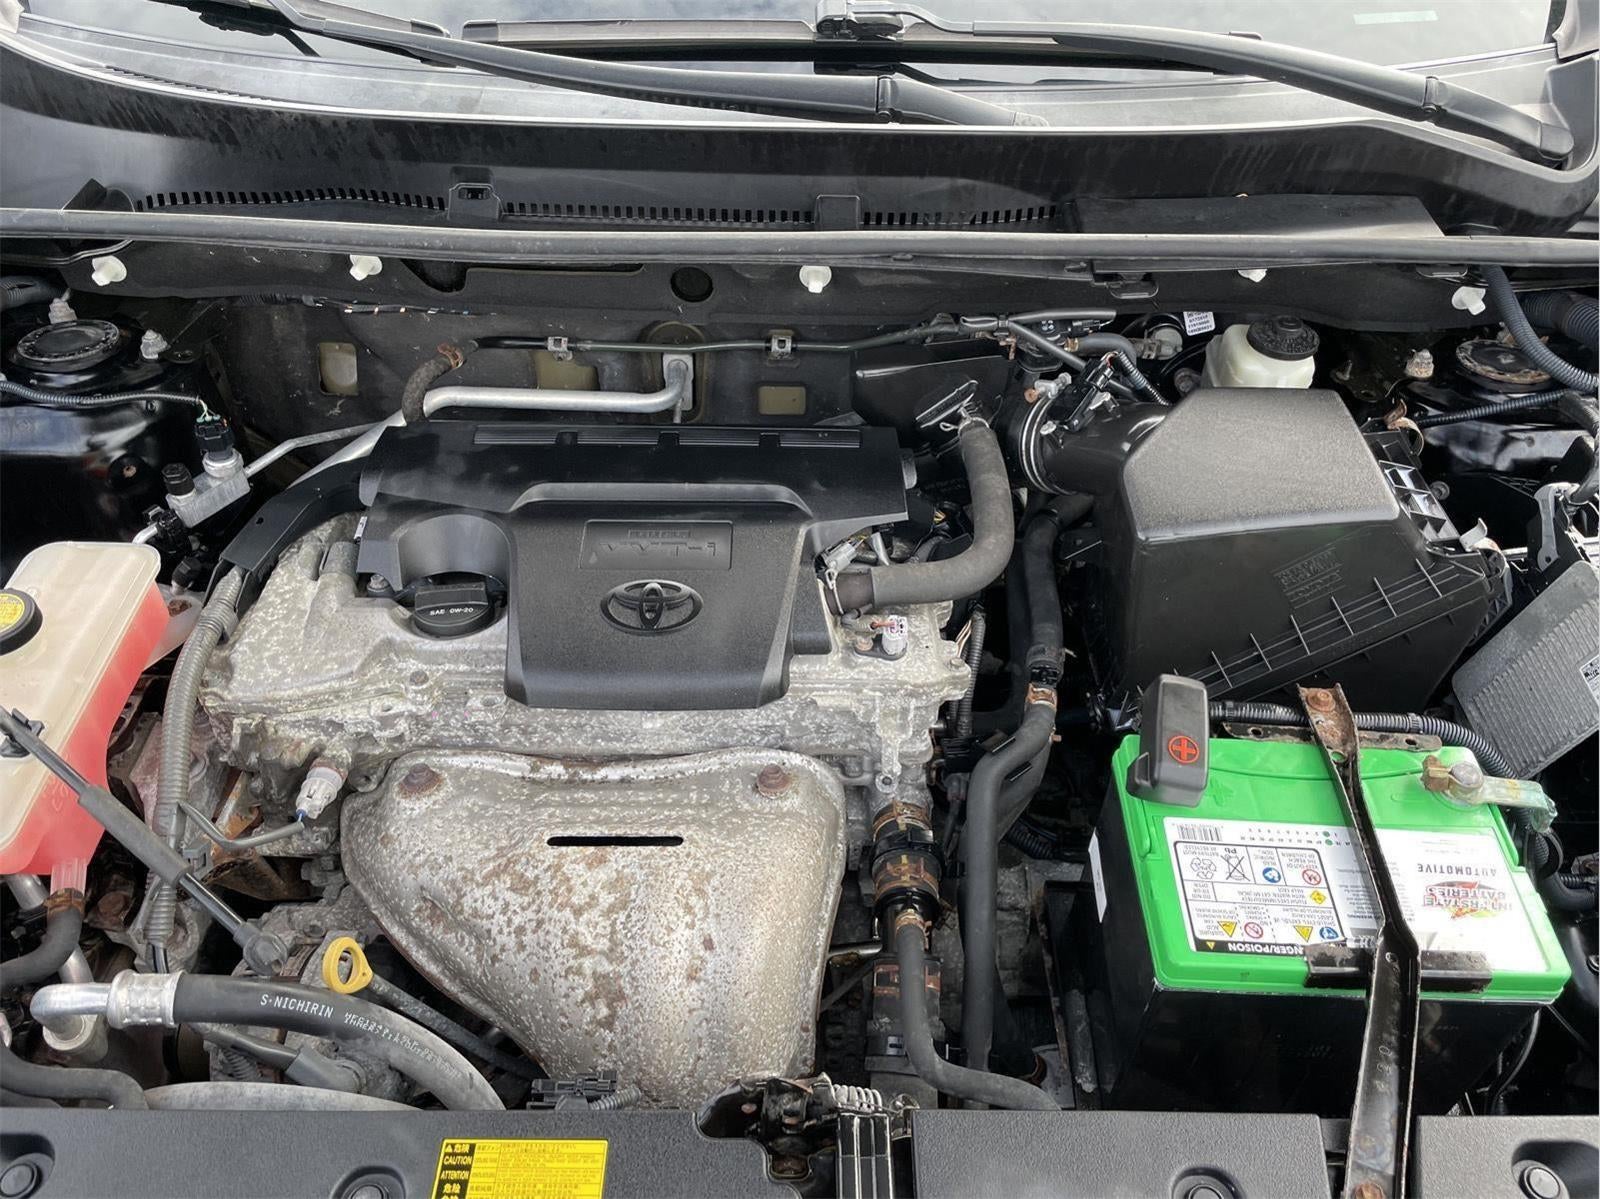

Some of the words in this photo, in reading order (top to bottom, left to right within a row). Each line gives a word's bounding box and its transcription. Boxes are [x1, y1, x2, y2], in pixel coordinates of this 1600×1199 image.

[429, 608, 446, 616] SAE
[449, 606, 474, 614] 0W-20
[1417, 863, 1497, 877] AUTOMOTIVE
[1228, 943, 1304, 955] NGER/POISON
[443, 1156, 472, 1165] CAUTION
[440, 1170, 470, 1180] ATTENTION
